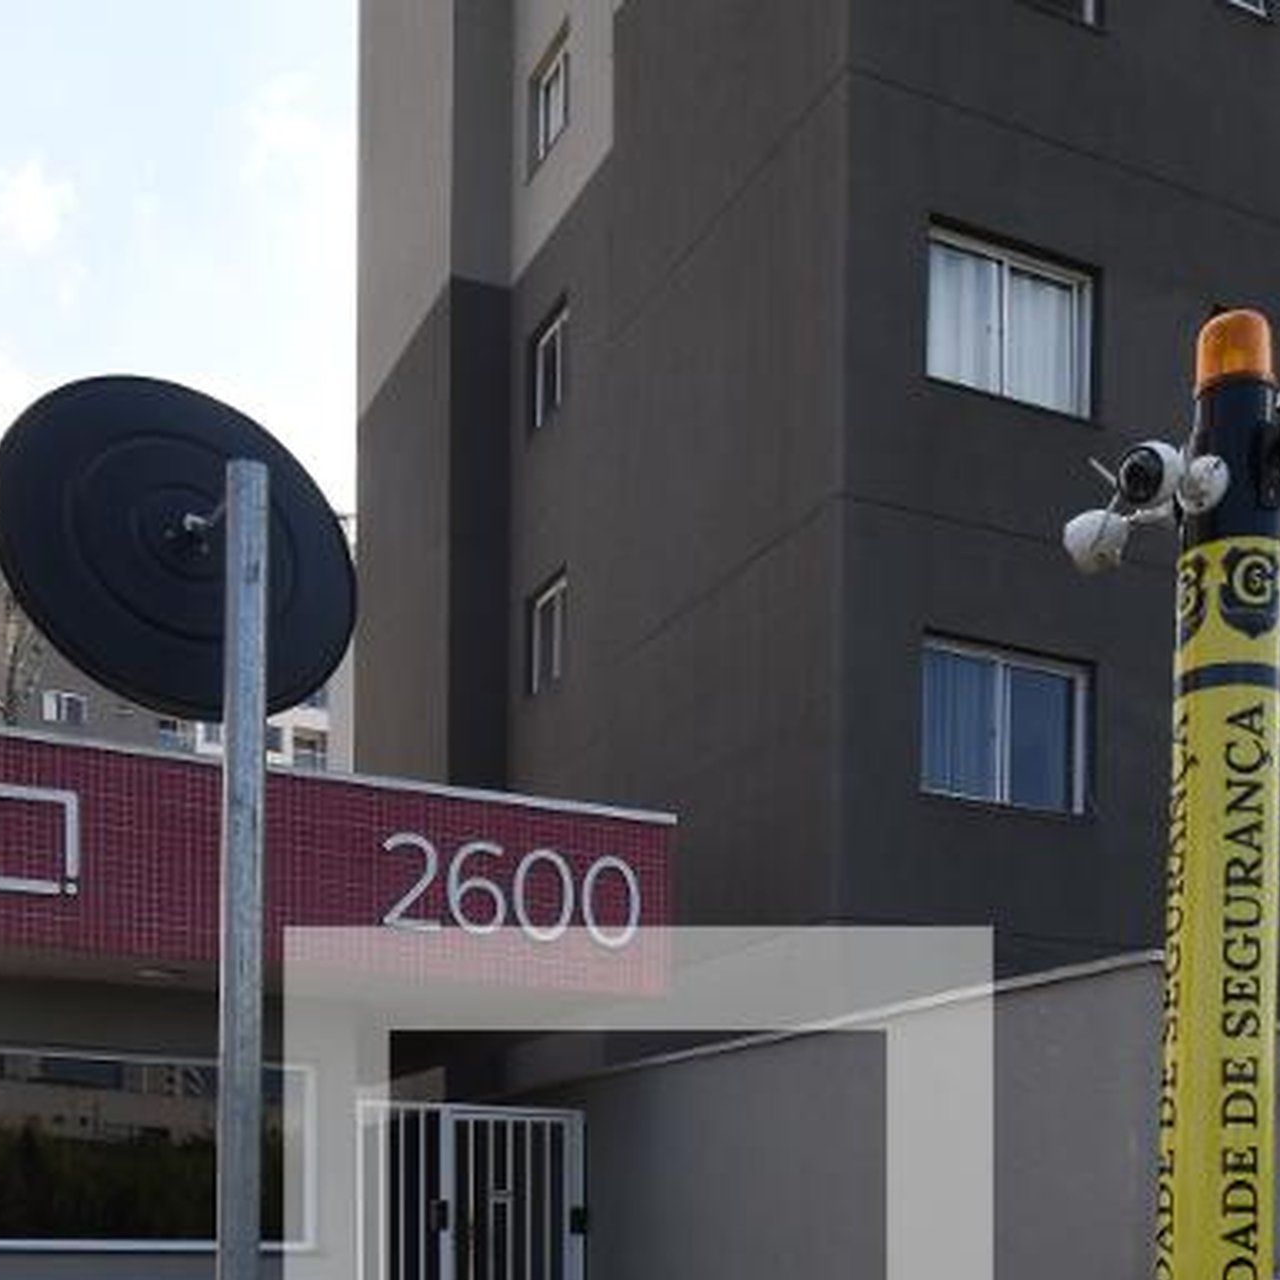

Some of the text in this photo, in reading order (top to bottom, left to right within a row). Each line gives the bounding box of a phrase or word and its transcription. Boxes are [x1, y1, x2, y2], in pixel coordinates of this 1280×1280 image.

[382, 832, 641, 948] 2600
[1222, 702, 1271, 1038] SEGURANÇA
[1222, 1056, 1260, 1127] DE
